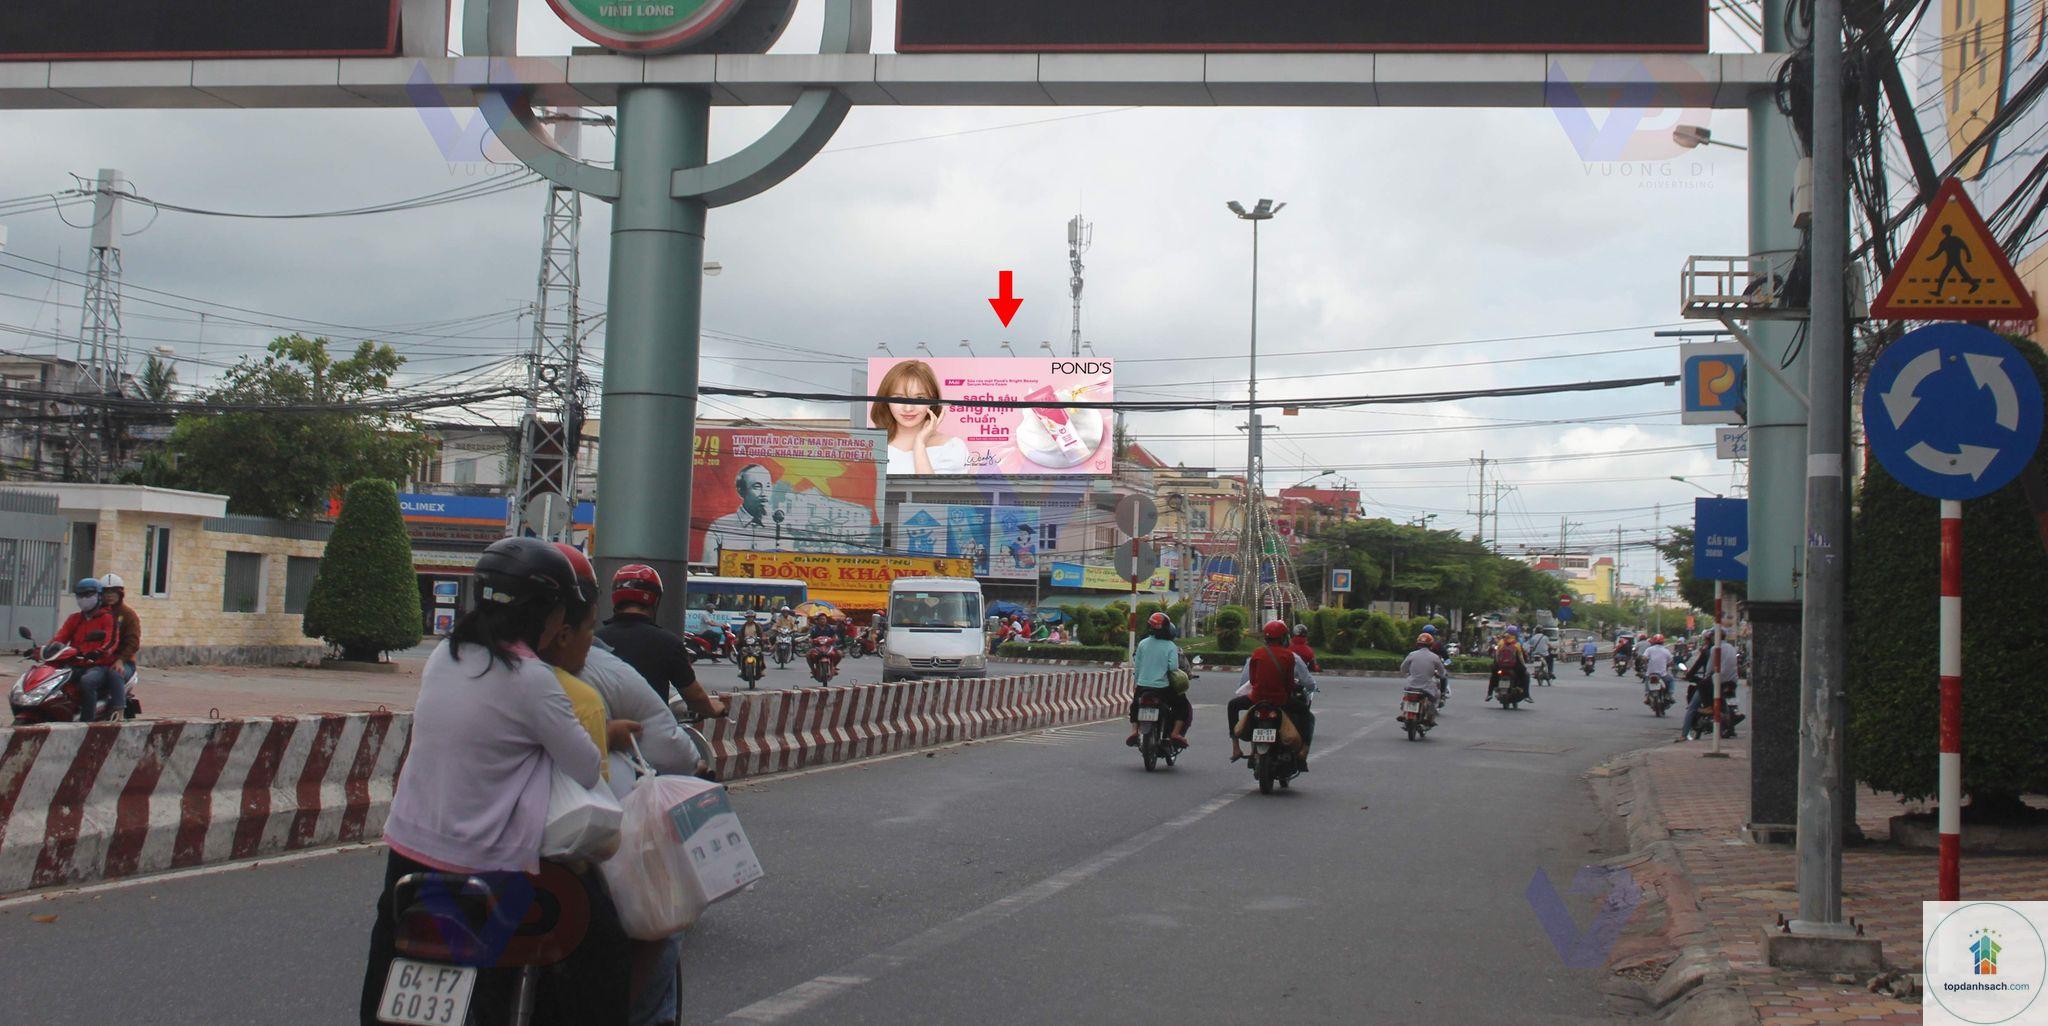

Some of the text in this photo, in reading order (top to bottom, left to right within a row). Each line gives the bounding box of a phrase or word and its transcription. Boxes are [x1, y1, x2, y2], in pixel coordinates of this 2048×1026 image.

[637, 5, 675, 17] LONG
[1051, 362, 1112, 375] POND'S
[980, 424, 1010, 435] Hàn
[732, 434, 754, 446] TINH
[780, 435, 806, 446] CÁCH
[806, 437, 835, 448] MẠNG
[867, 439, 875, 448] 8
[835, 557, 880, 565] TRUNG
[759, 560, 929, 581] ĐỒNG KHÁNH
[391, 992, 455, 1023] 6033
